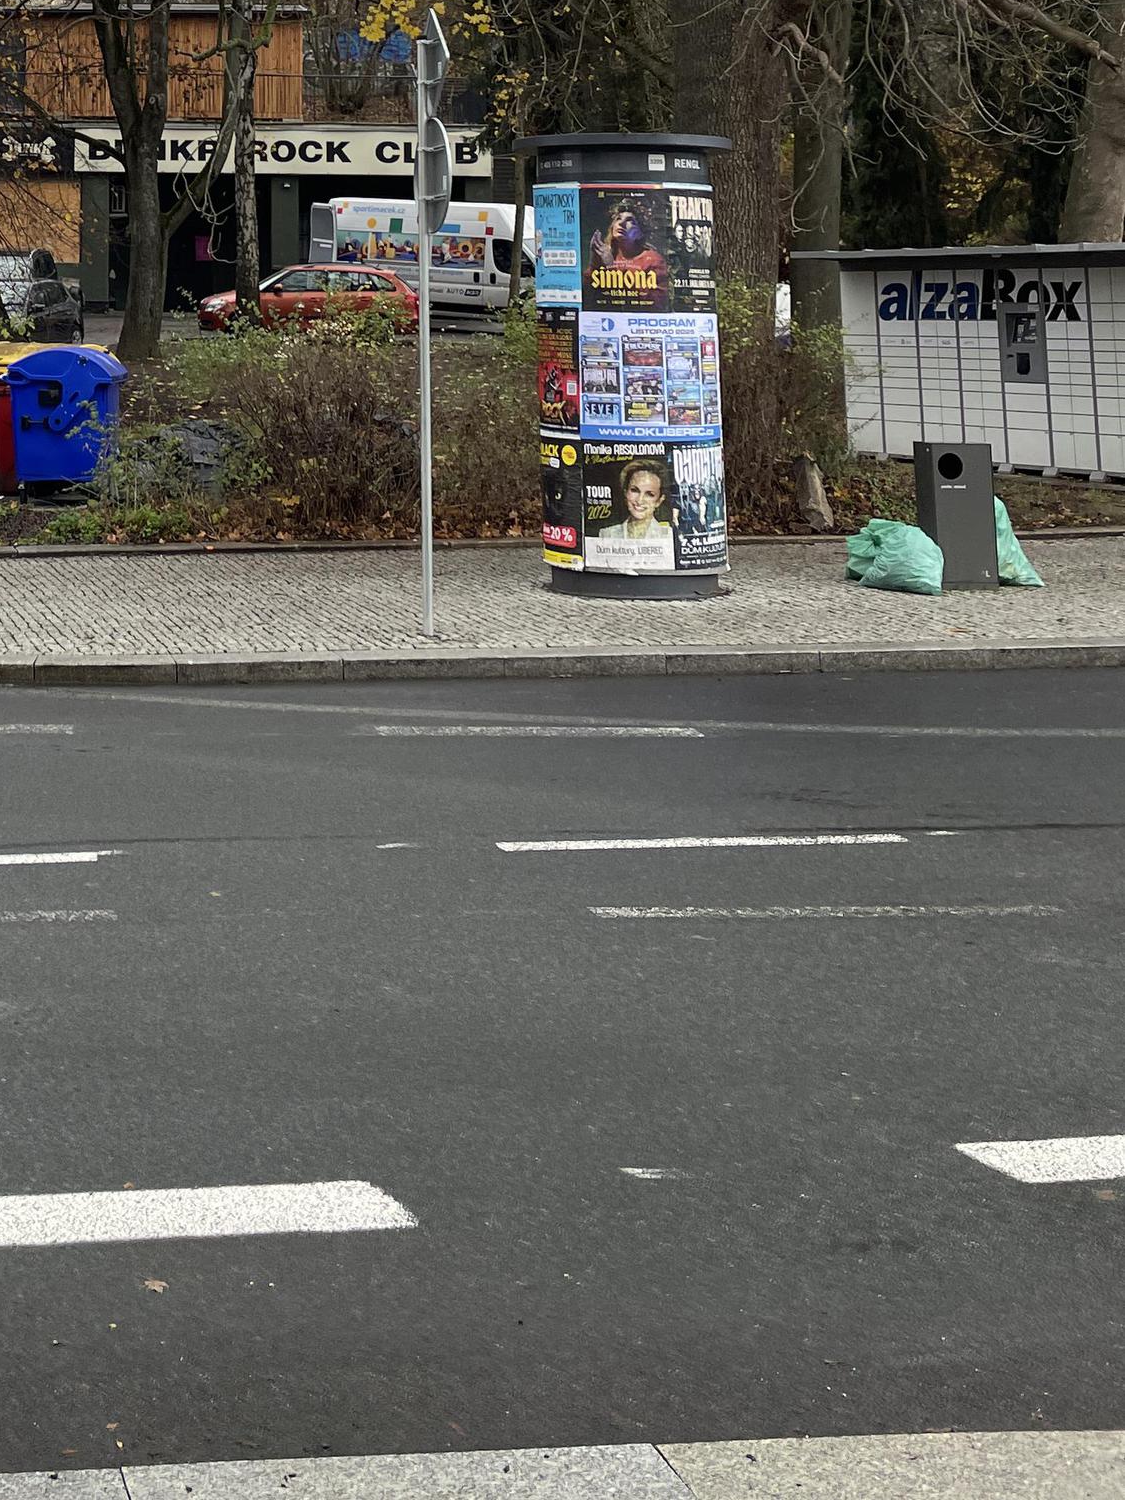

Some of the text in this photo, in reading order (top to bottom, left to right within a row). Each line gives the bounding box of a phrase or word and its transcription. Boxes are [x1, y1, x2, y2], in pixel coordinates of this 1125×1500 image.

[89, 139, 227, 161] BKR
[375, 141, 479, 164] CLB
[674, 158, 700, 170] RENGL
[591, 266, 658, 289] simona
[878, 269, 1083, 321] alzaBox
[627, 318, 696, 328] PROGRAM
[585, 402, 620, 415] SEVER
[583, 443, 612, 455] Monika
[586, 485, 611, 499] TOUR
